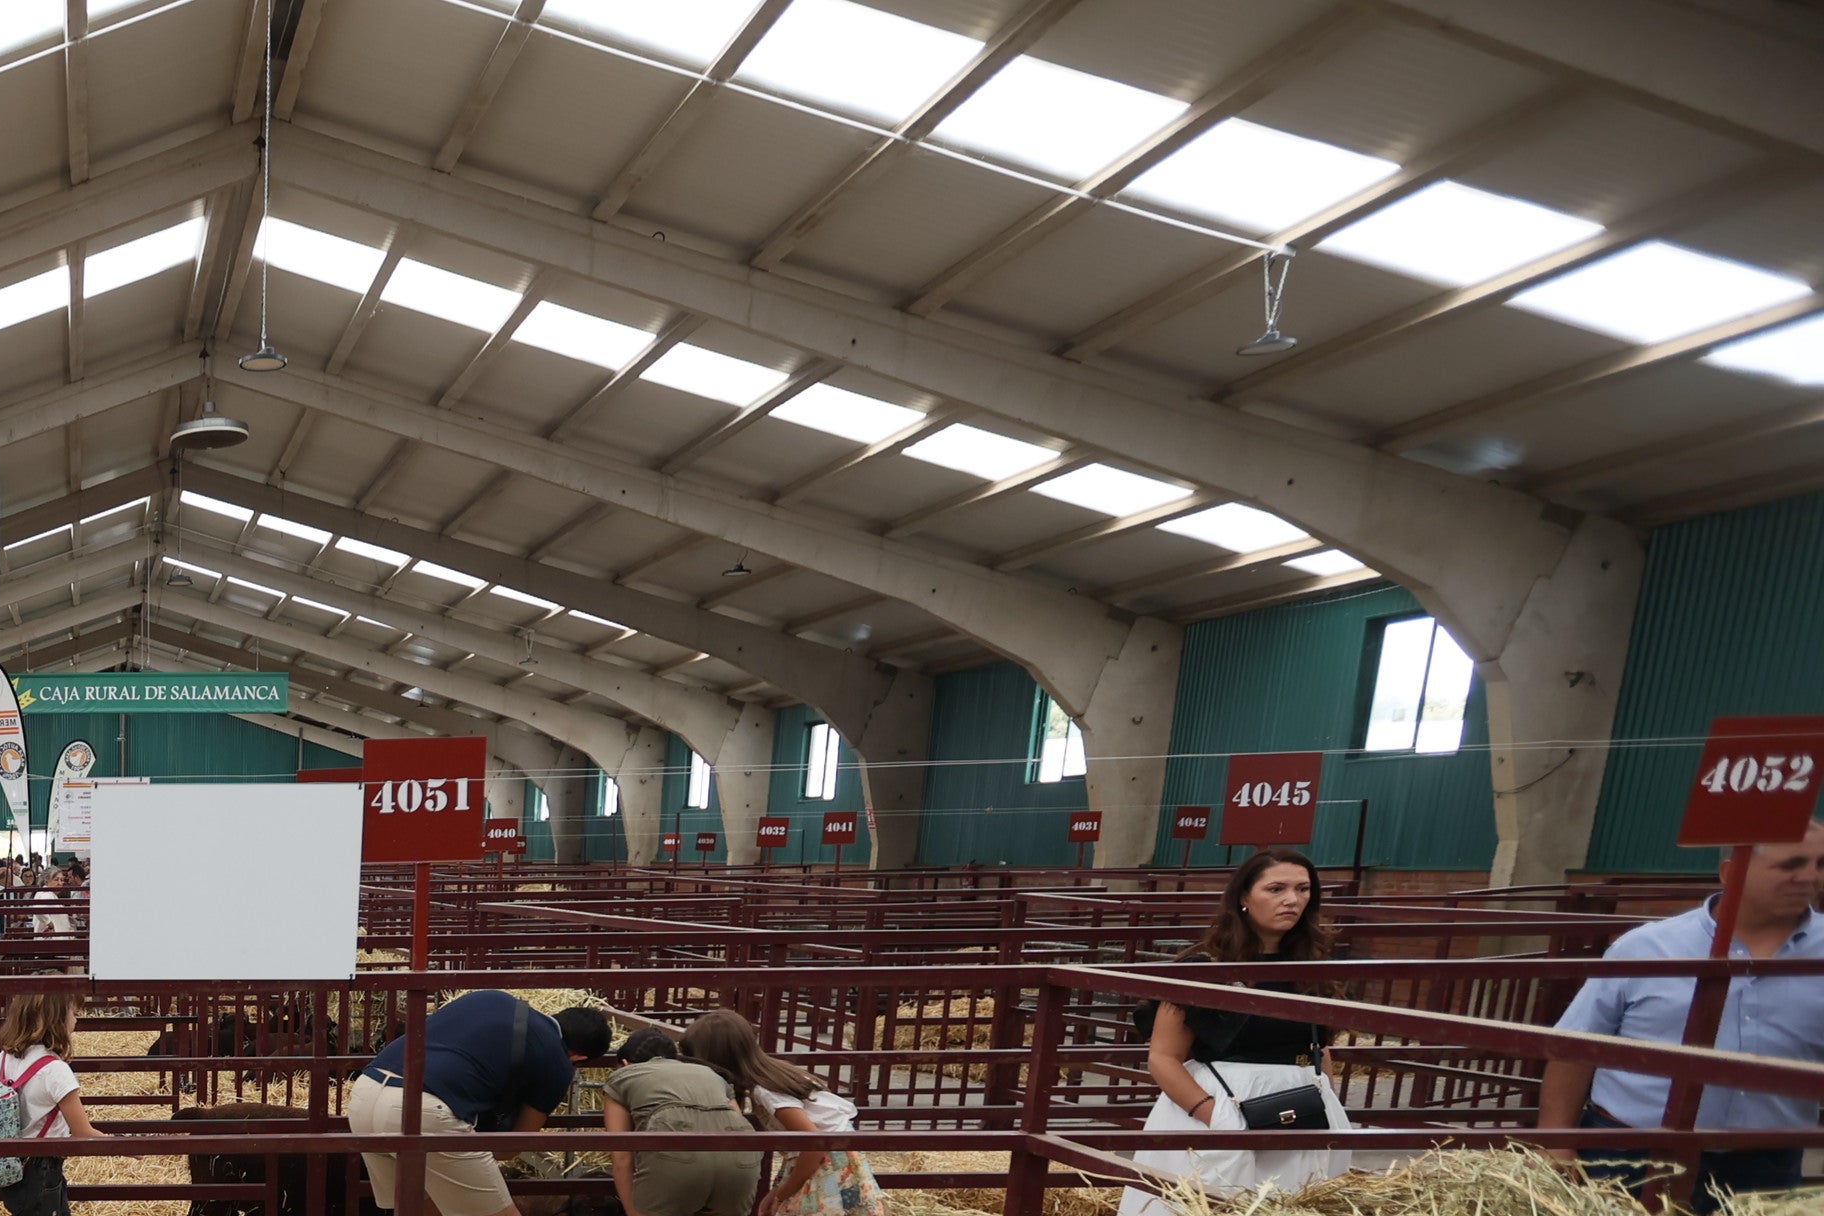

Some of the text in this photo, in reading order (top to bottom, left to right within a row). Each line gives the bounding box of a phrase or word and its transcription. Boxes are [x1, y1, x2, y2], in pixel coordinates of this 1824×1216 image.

[39, 685, 280, 705] CAJA RURAL DE SALAMANCA
[1701, 755, 1814, 793] 4052
[371, 777, 471, 815] 4051
[1232, 781, 1312, 807] 4045
[825, 821, 854, 832] 4041
[1071, 821, 1098, 831] 4031
[1177, 817, 1207, 828] 4042
[487, 828, 517, 838] 4040
[759, 826, 786, 836] 4032
